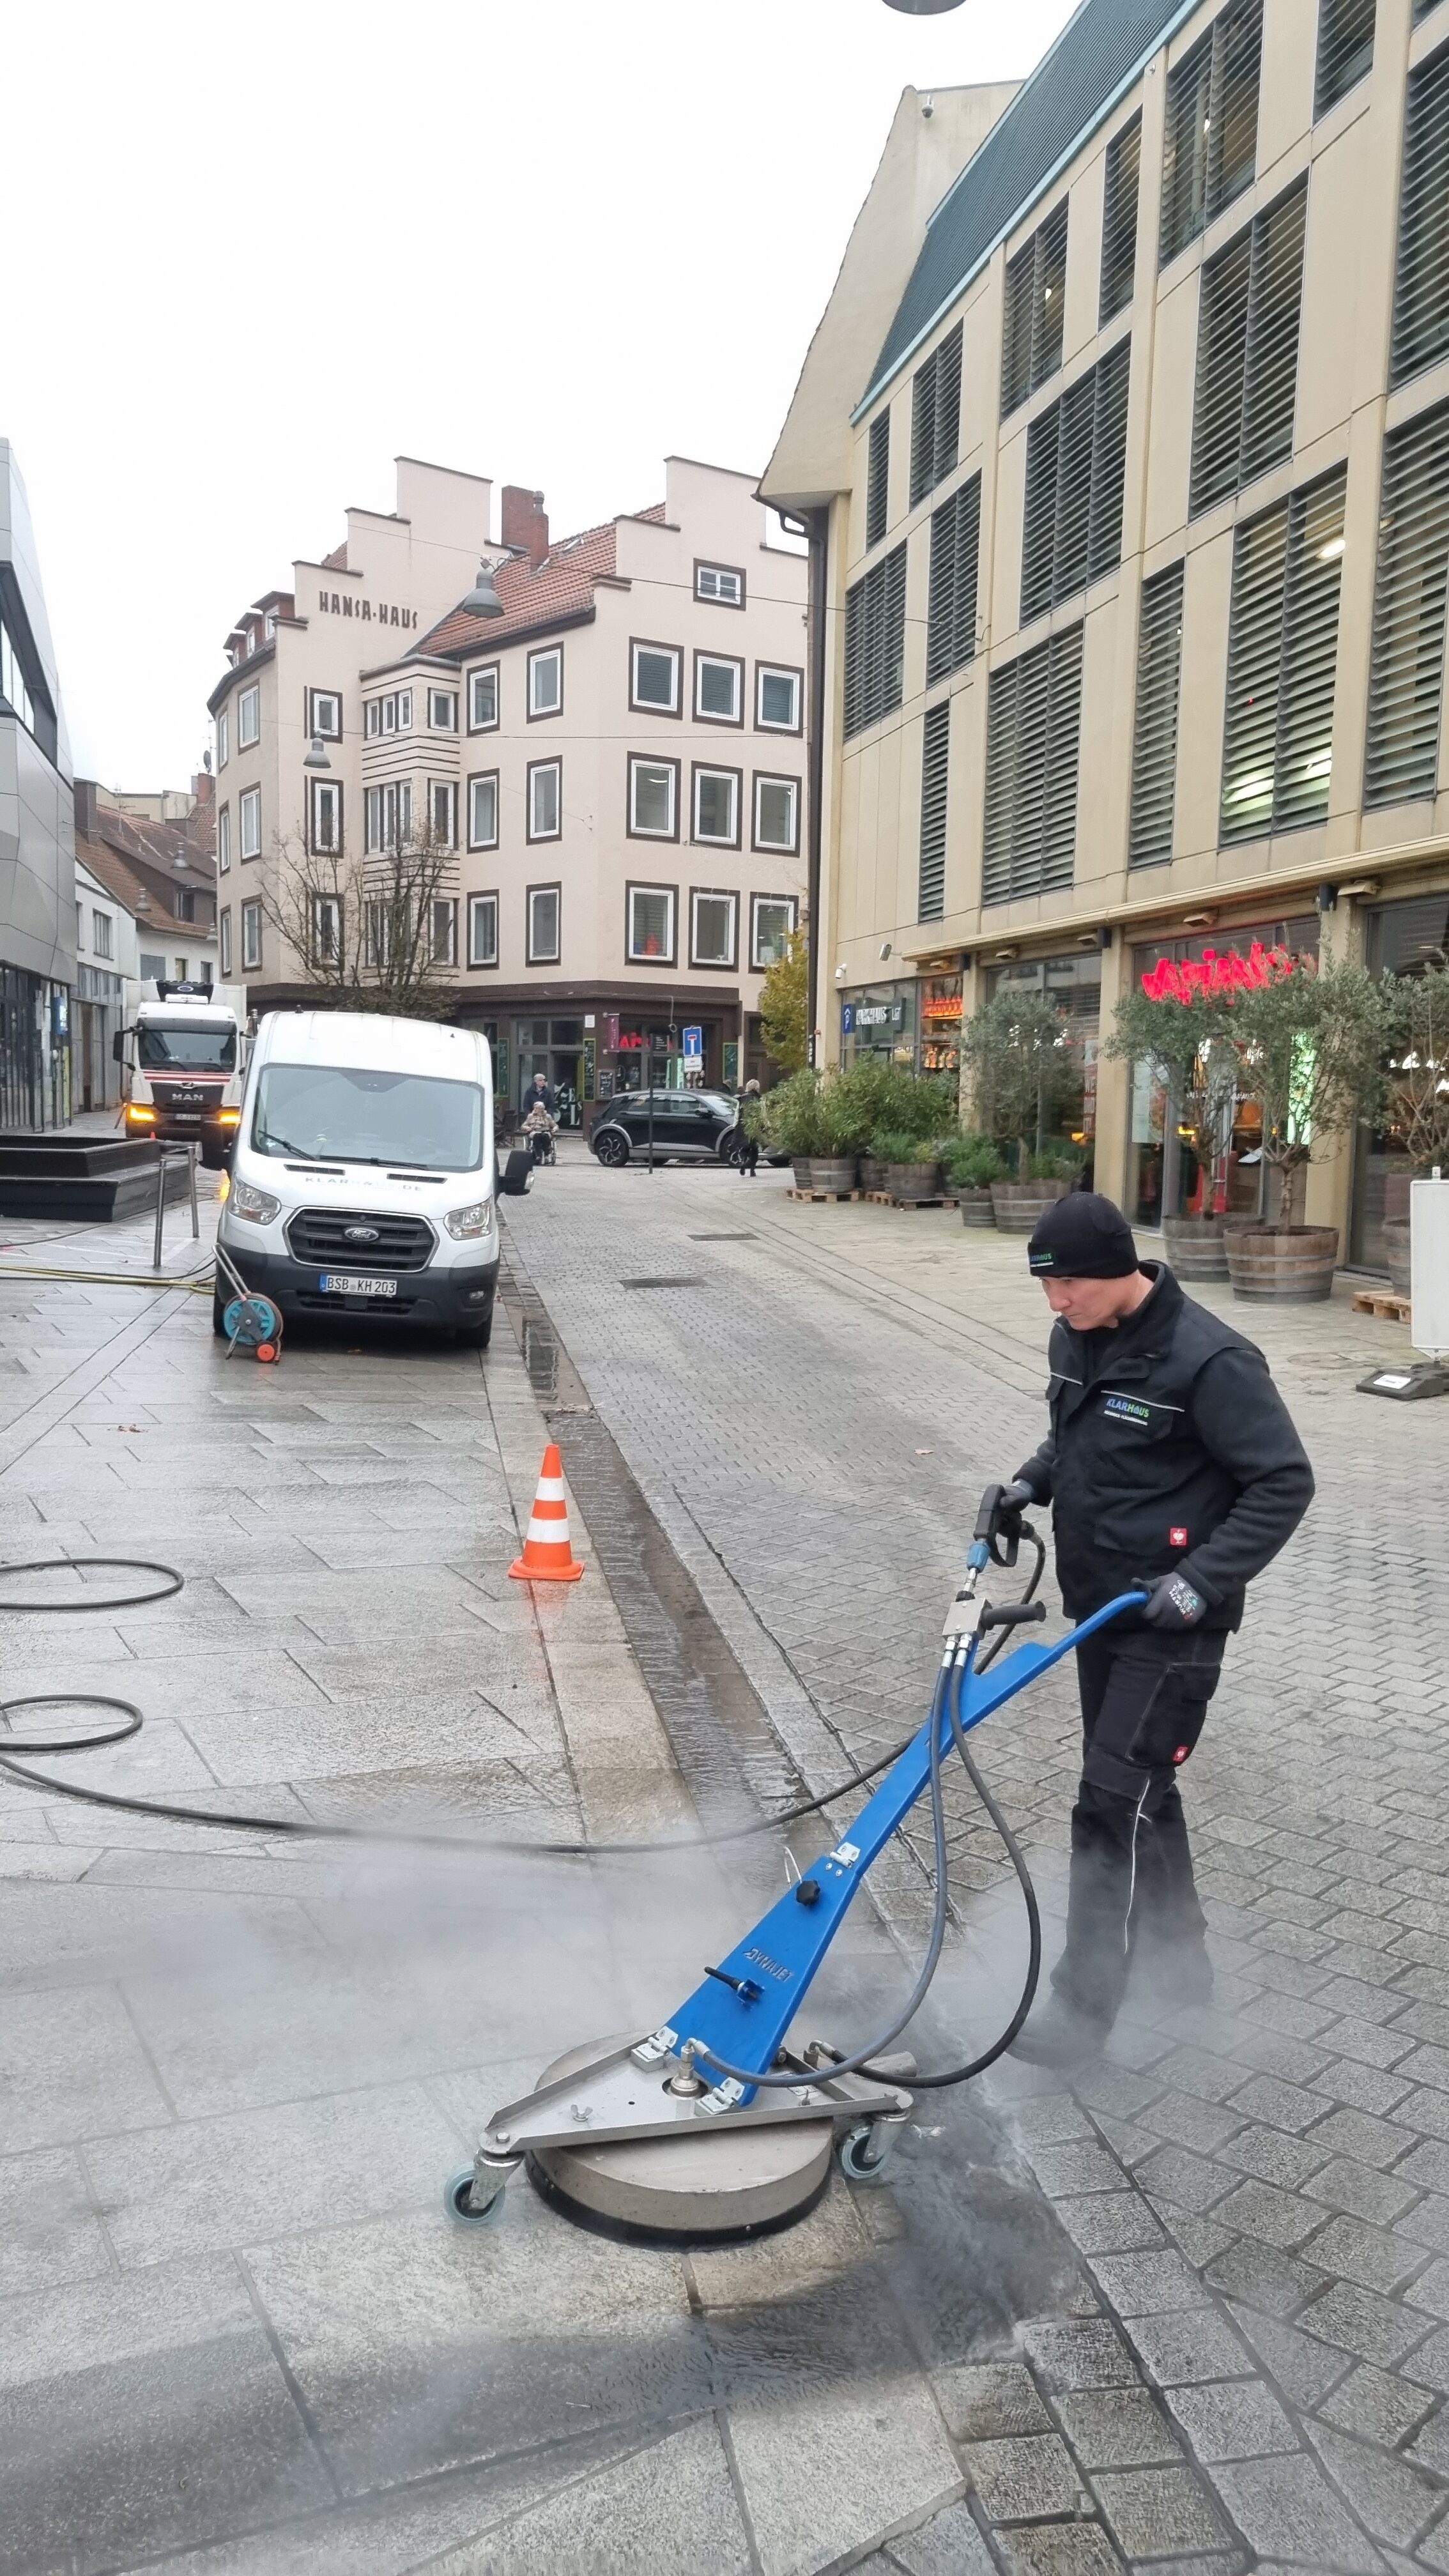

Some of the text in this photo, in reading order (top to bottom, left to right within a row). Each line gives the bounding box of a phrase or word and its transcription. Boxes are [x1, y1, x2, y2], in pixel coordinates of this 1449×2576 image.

[856, 1007, 887, 1025] PARKHAUS
[351, 1229, 371, 1239] Ford
[328, 1277, 395, 1294] BSB KH 203
[743, 1947, 793, 1982] DYNAJET
